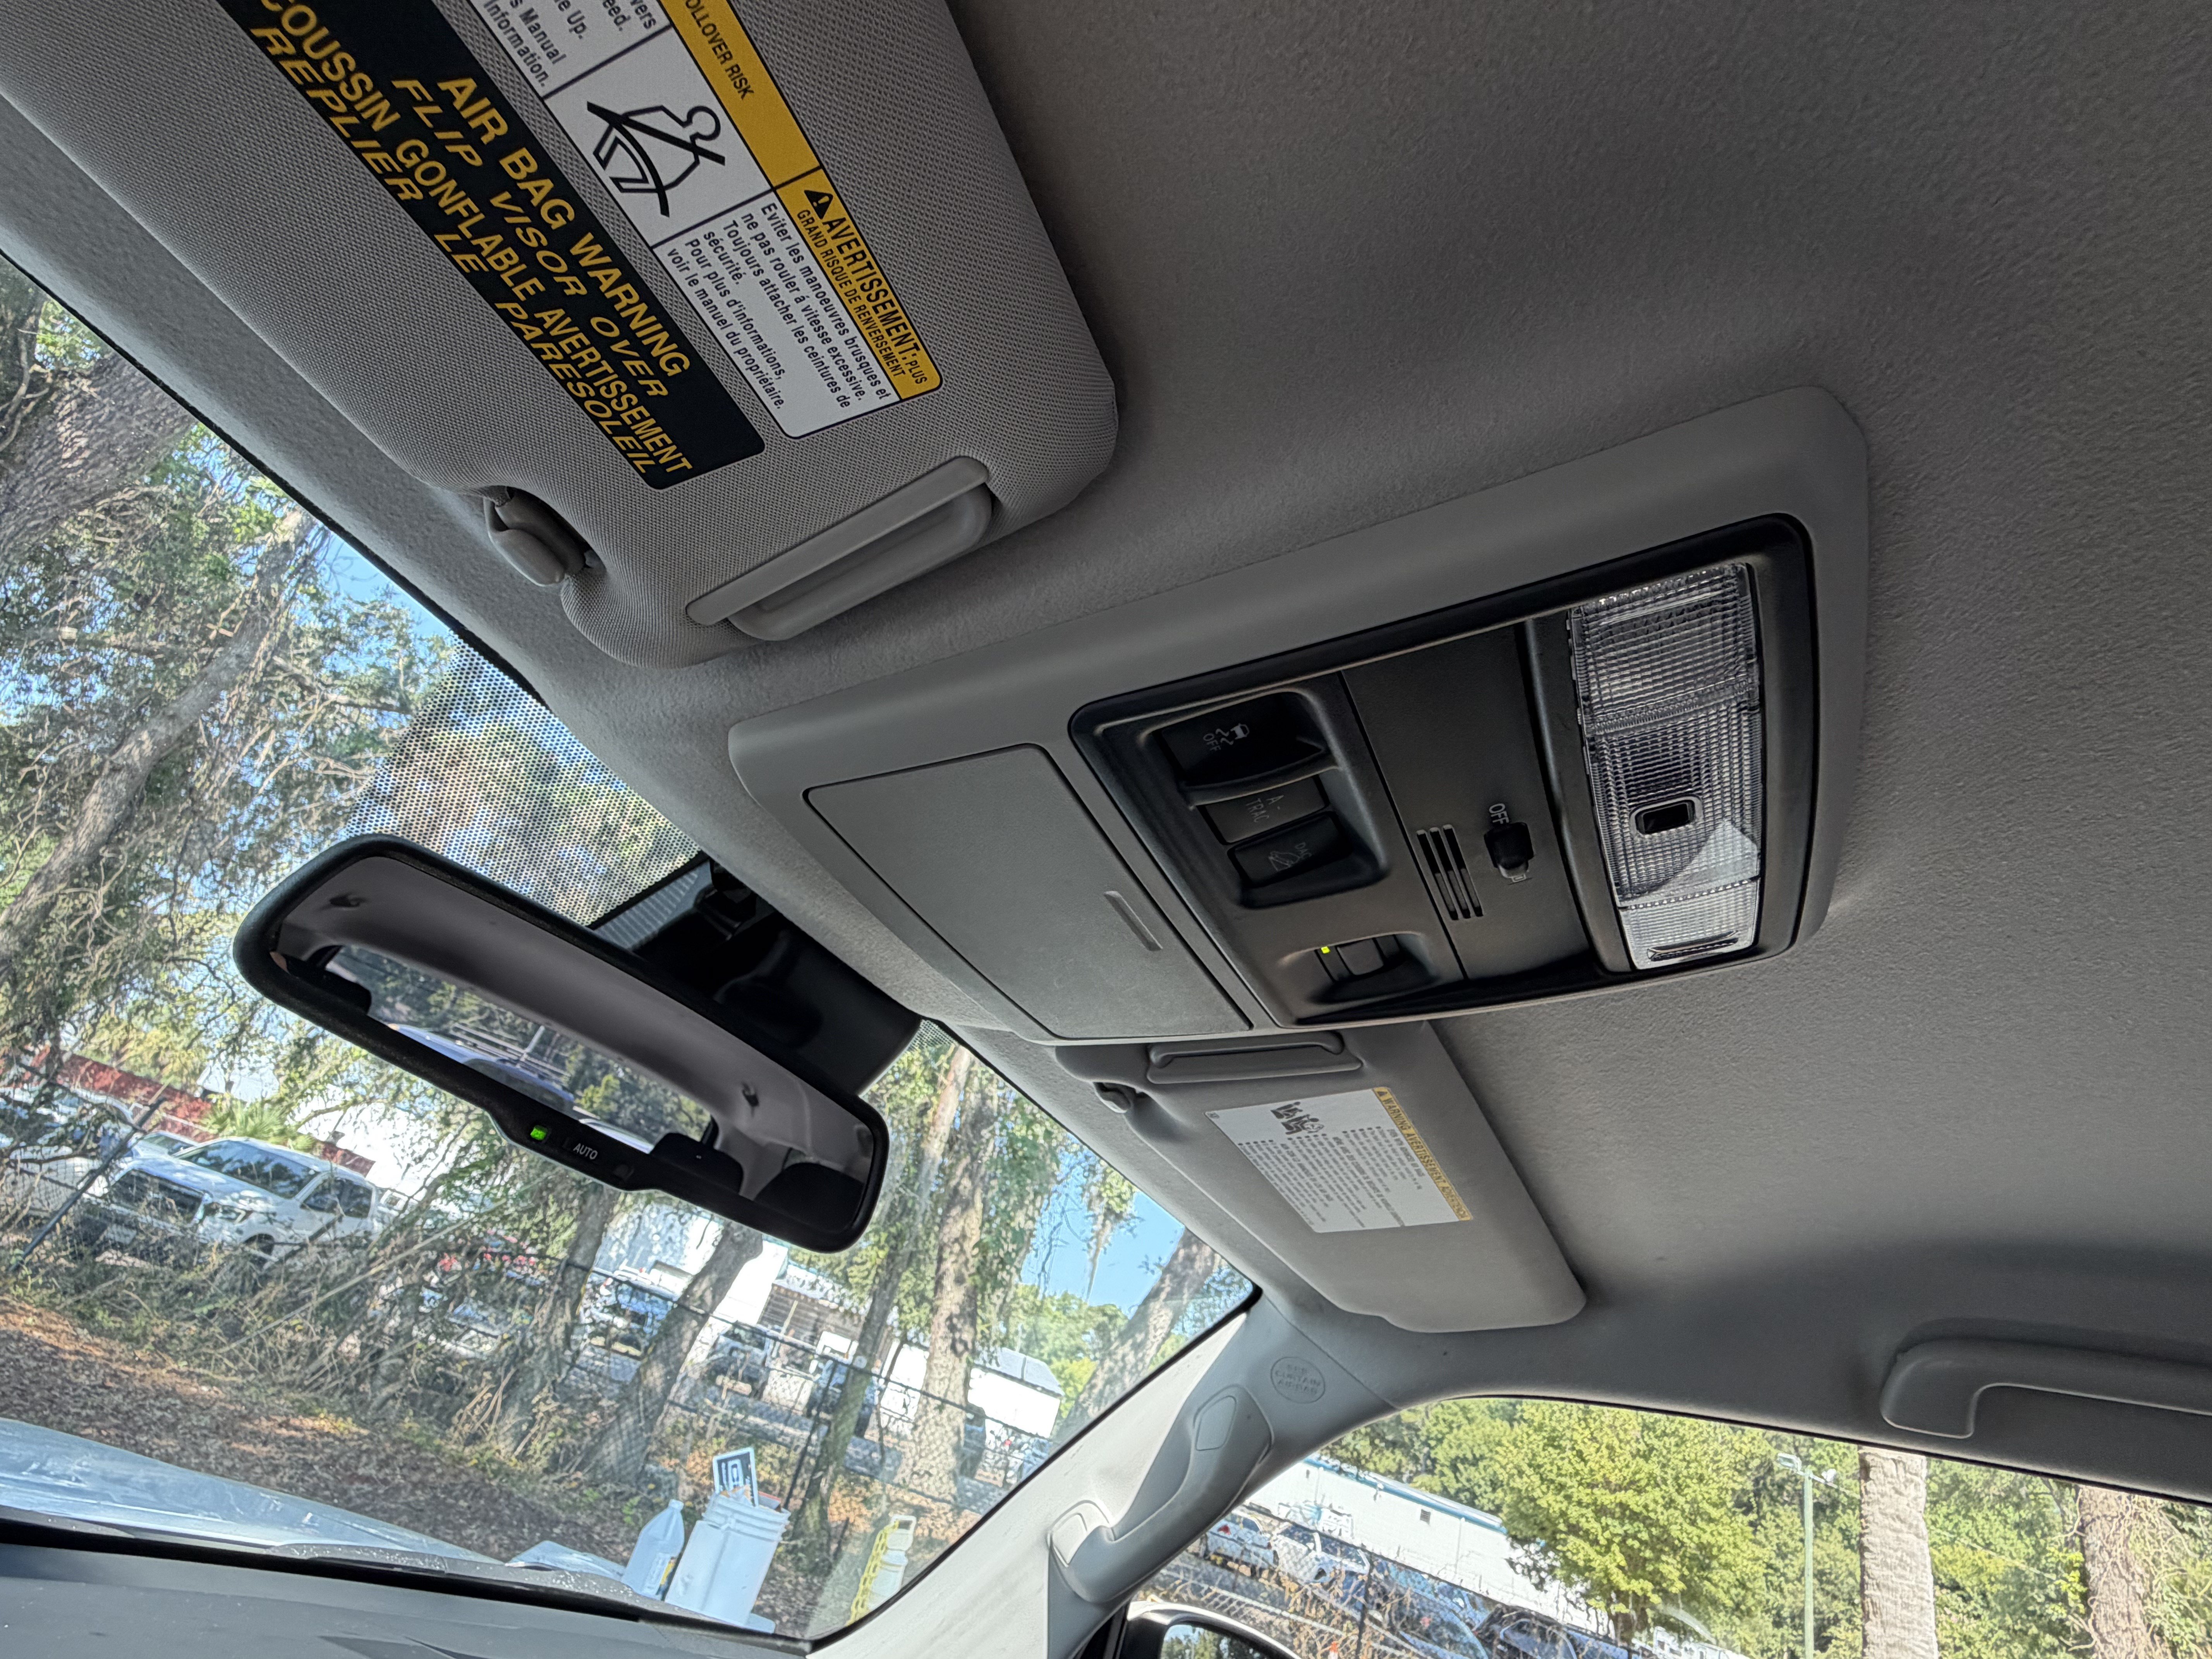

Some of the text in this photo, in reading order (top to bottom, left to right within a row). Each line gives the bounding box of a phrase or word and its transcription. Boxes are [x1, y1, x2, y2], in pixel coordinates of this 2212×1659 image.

[483, 0, 549, 87] Information.
[519, 7, 567, 65] Manual
[567, 10, 586, 39] Up.
[603, 0, 631, 31] eed.
[630, 0, 657, 29] vers
[685, 0, 754, 100] OLLOVER RISK
[250, 28, 656, 474] REPLIER LE PARESOLEIL
[391, 79, 668, 396] FLIP VISOR OVER
[437, 77, 690, 376] AIR BAG WARNING
[703, 232, 746, 285] sécurité.
[396, 139, 546, 301] GONFLABLE
[534, 309, 693, 472] AVERTISSEMENT
[667, 249, 784, 409] voir le manuel du propriétaire.
[685, 239, 785, 380] Pour plus d'informations,
[723, 220, 850, 407] Toujours attacher les ceintures de
[741, 213, 758, 230] ne
[750, 232, 775, 256] pas
[769, 258, 800, 293] rouler
[801, 305, 832, 344] vitesse
[827, 347, 866, 400] excessive.
[761, 203, 891, 399] Eviter les manoeuvres brusques et
[797, 210, 906, 376] GRAND RISQUE DE RENVERSEMENT
[906, 359, 927, 384] PLUS
[1203, 733, 1221, 751] OFF
[1245, 798, 1269, 823] TRAC
[1489, 803, 1509, 824] OFF
[573, 1143, 598, 1160] AUTO
[1382, 1097, 1446, 1186] WARNING AVERTISSEMENT
